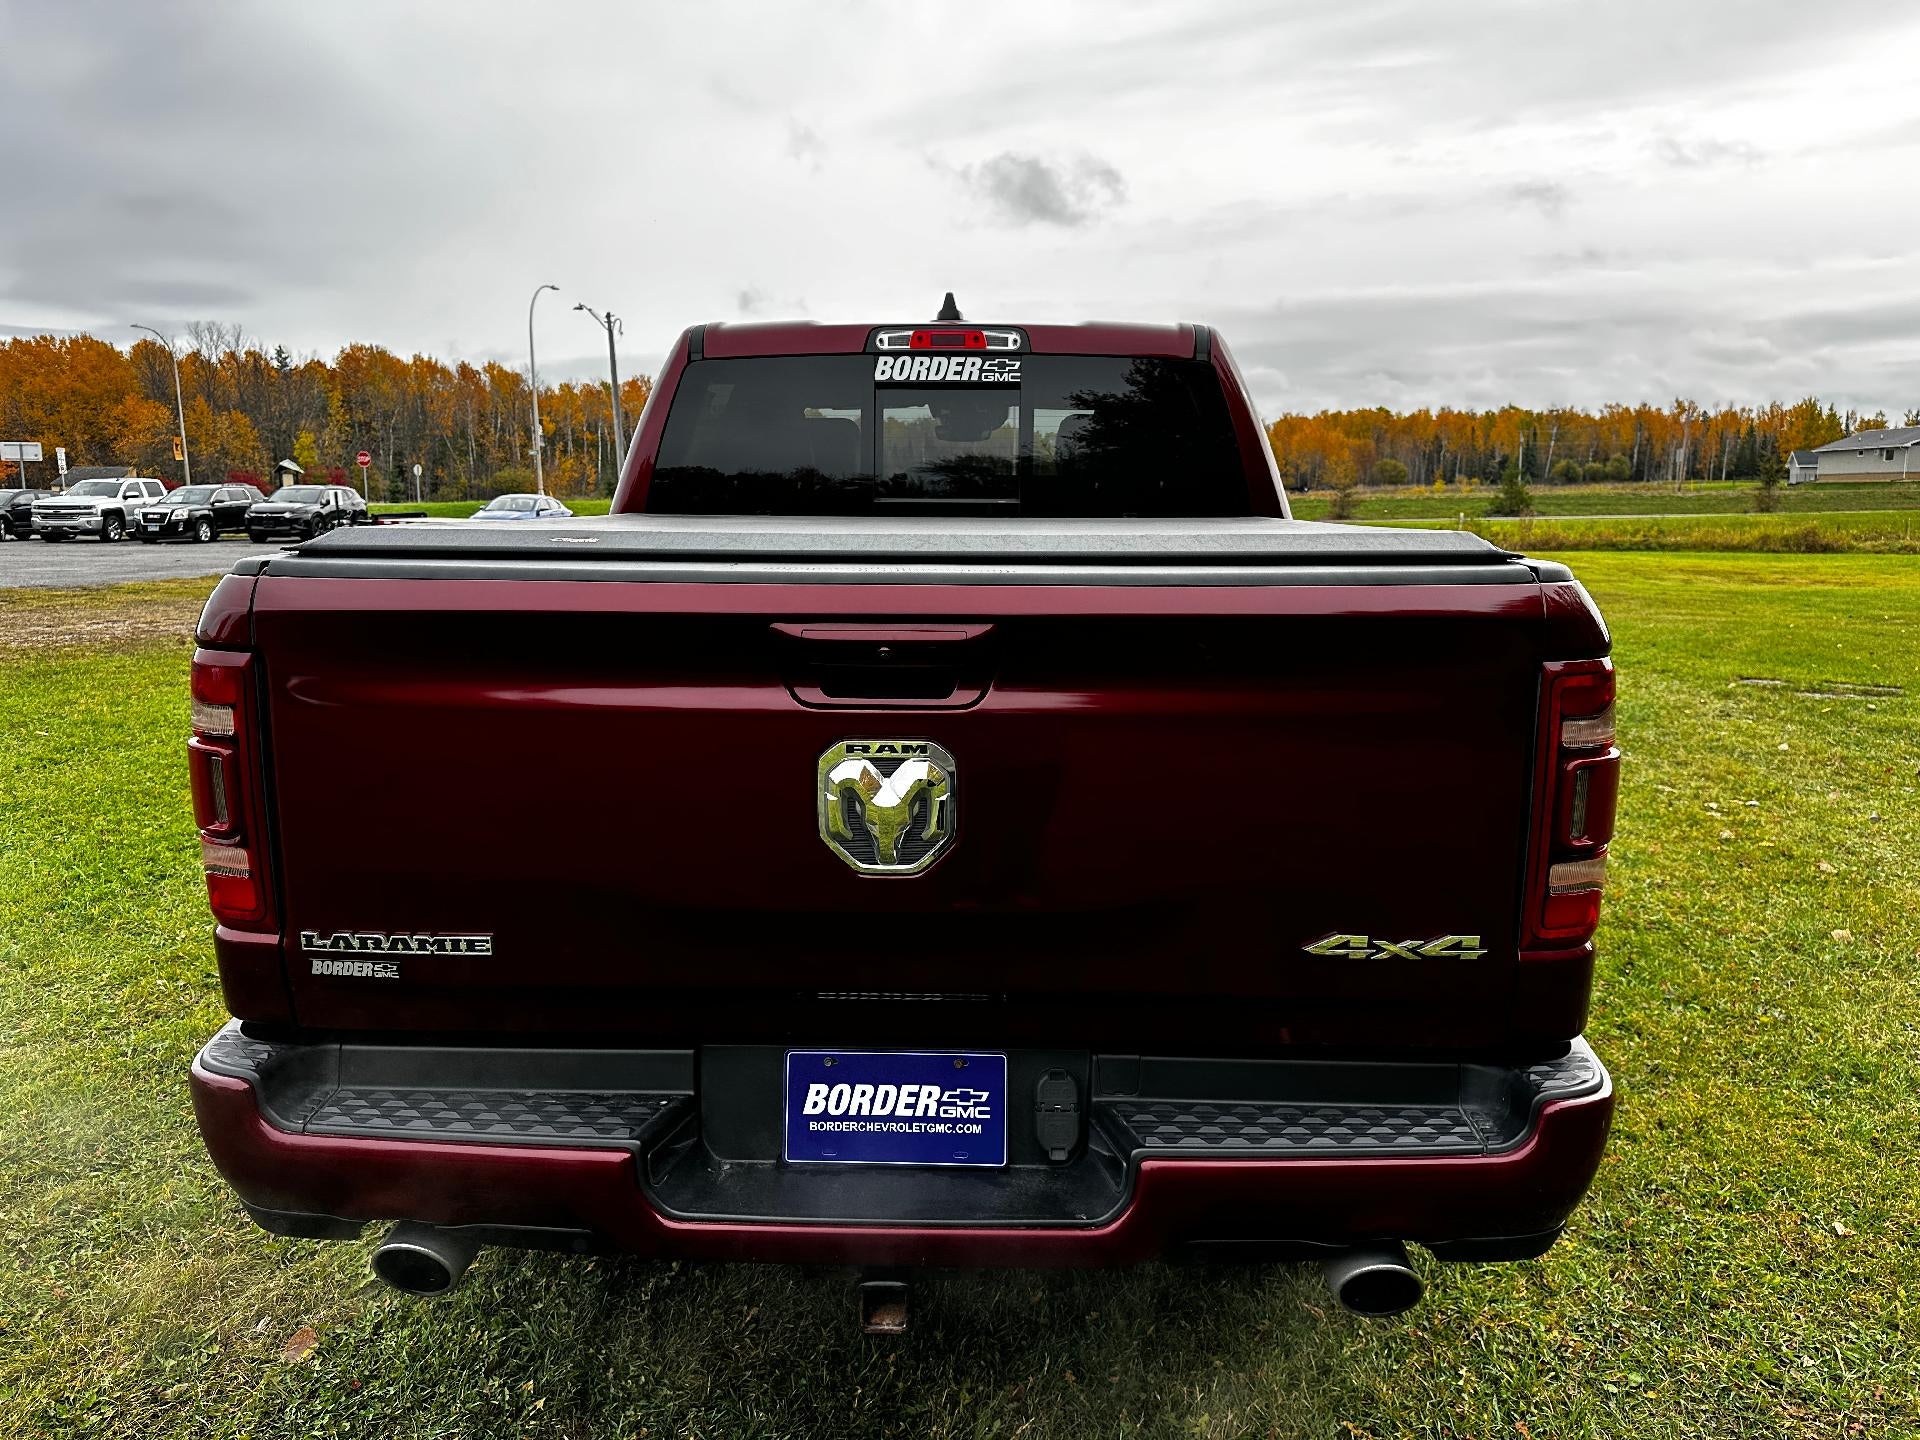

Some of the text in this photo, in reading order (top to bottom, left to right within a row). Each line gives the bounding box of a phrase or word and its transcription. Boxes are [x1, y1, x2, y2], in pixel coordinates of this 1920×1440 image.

[875, 356, 1022, 382] BORDER GMC
[845, 744, 929, 754] RAM
[300, 931, 493, 956] LARAMIE
[311, 960, 374, 977] BORDER
[803, 1084, 991, 1119] BORDER GMC
[809, 1121, 982, 1134] BORDERCHEVROLETGMC.COM
